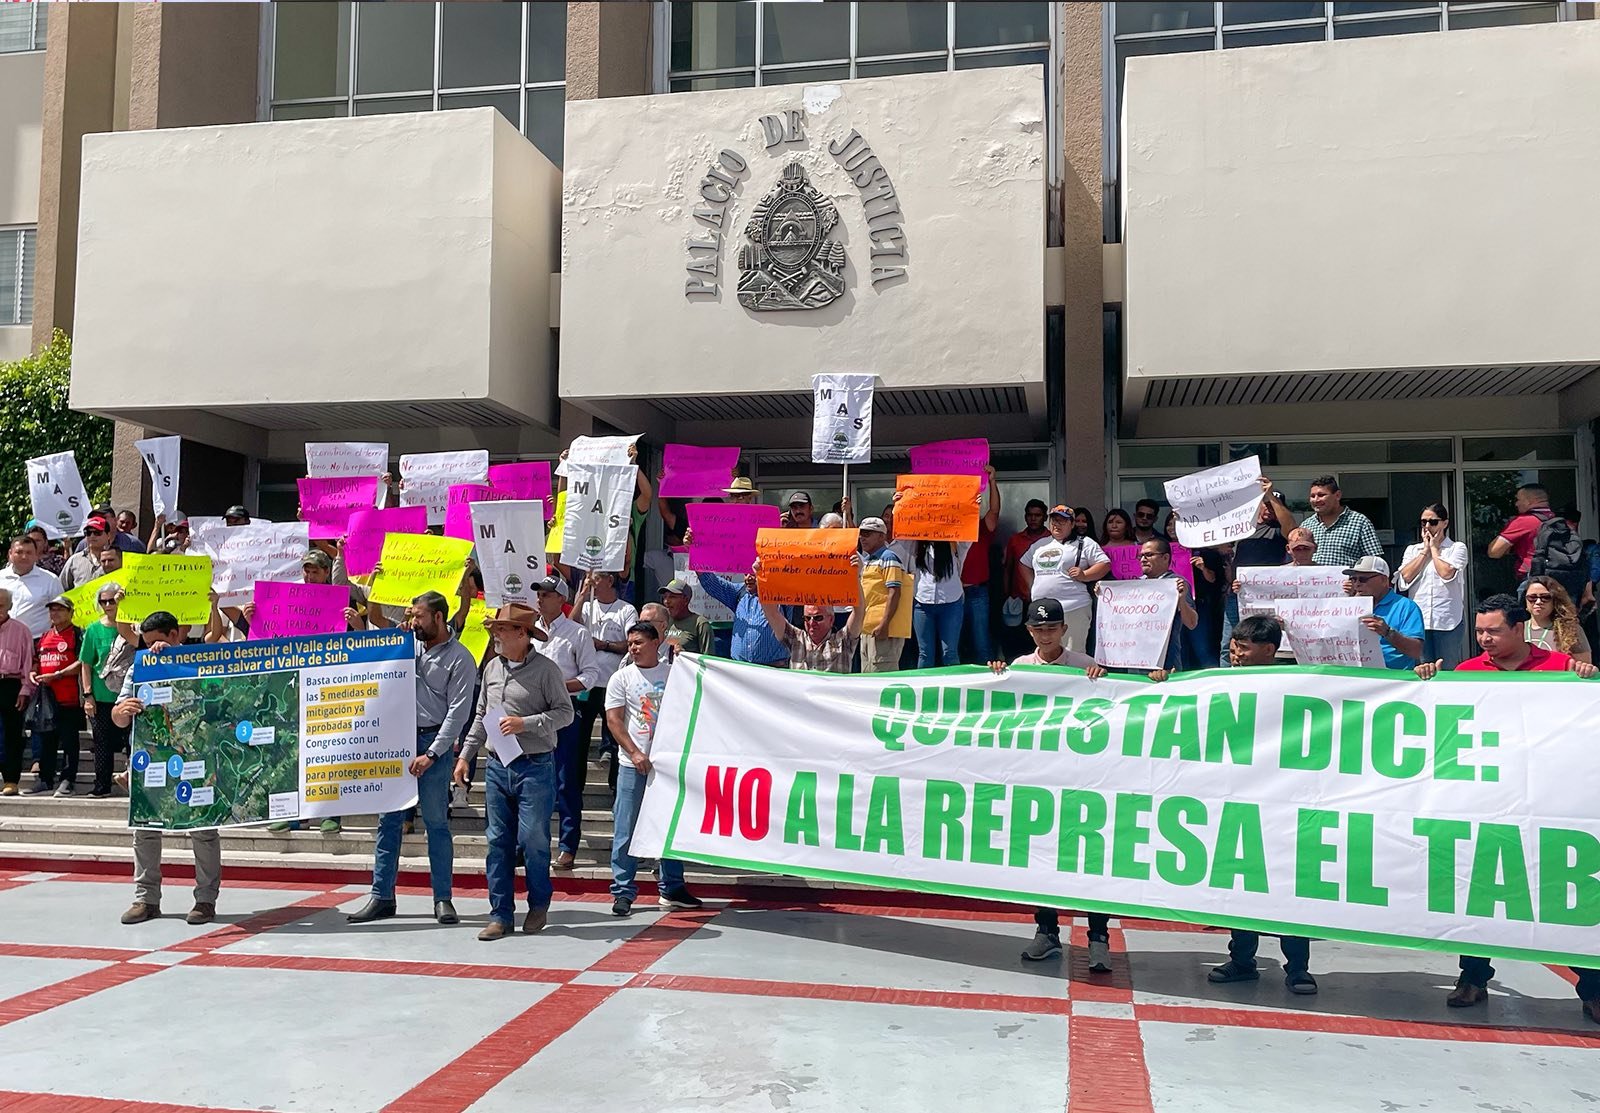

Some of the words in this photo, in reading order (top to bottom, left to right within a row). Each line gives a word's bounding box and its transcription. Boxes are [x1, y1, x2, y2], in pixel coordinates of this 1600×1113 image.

[685, 148, 747, 297] PALACIO
[758, 109, 805, 149] DE
[828, 128, 906, 290] JUSTICIA
[1203, 530, 1217, 543] EL
[143, 654, 157, 666] No
[159, 656, 173, 665] es
[175, 649, 231, 665] necesario
[234, 643, 280, 660] destruir
[282, 643, 293, 655] el
[295, 640, 324, 655] Valle
[326, 639, 343, 651] del
[345, 633, 405, 650] Quimistán
[198, 663, 225, 677] para
[227, 659, 262, 673] salvar
[264, 657, 275, 670] el
[277, 656, 306, 669] Valle
[308, 654, 323, 667] de
[324, 651, 349, 664] Sula
[306, 677, 331, 687] Basta
[332, 676, 349, 684] con
[350, 670, 407, 684] implementar
[306, 692, 319, 702] las
[320, 691, 326, 700] 5
[328, 687, 365, 700] medidas
[366, 687, 378, 696] de
[306, 704, 352, 719] mitigación
[354, 705, 365, 715] ya
[242, 726, 247, 737] 3
[306, 720, 353, 736] aprobadas
[354, 719, 370, 731] por
[372, 717, 380, 727] el
[872, 683, 1258, 765] QUIMISTAN
[1279, 694, 1499, 782] DICE:
[306, 737, 347, 750] Congreso
[348, 736, 365, 745] con
[367, 735, 379, 744] un
[137, 755, 144, 766] 4
[173, 760, 178, 771] 1
[306, 751, 362, 767] presupuesto
[363, 748, 411, 760] autorizado
[306, 771, 326, 782] para
[328, 767, 367, 781] proteger
[369, 766, 377, 775] el
[379, 764, 401, 775] Valle
[181, 787, 187, 797] 2
[306, 787, 316, 797] de
[318, 785, 338, 796] Sula
[363, 782, 383, 793] año!
[700, 765, 772, 841] NO
[783, 771, 819, 847] A
[835, 773, 905, 856] LA
[922, 778, 1269, 894] REPRESA
[1295, 807, 1389, 907] EL
